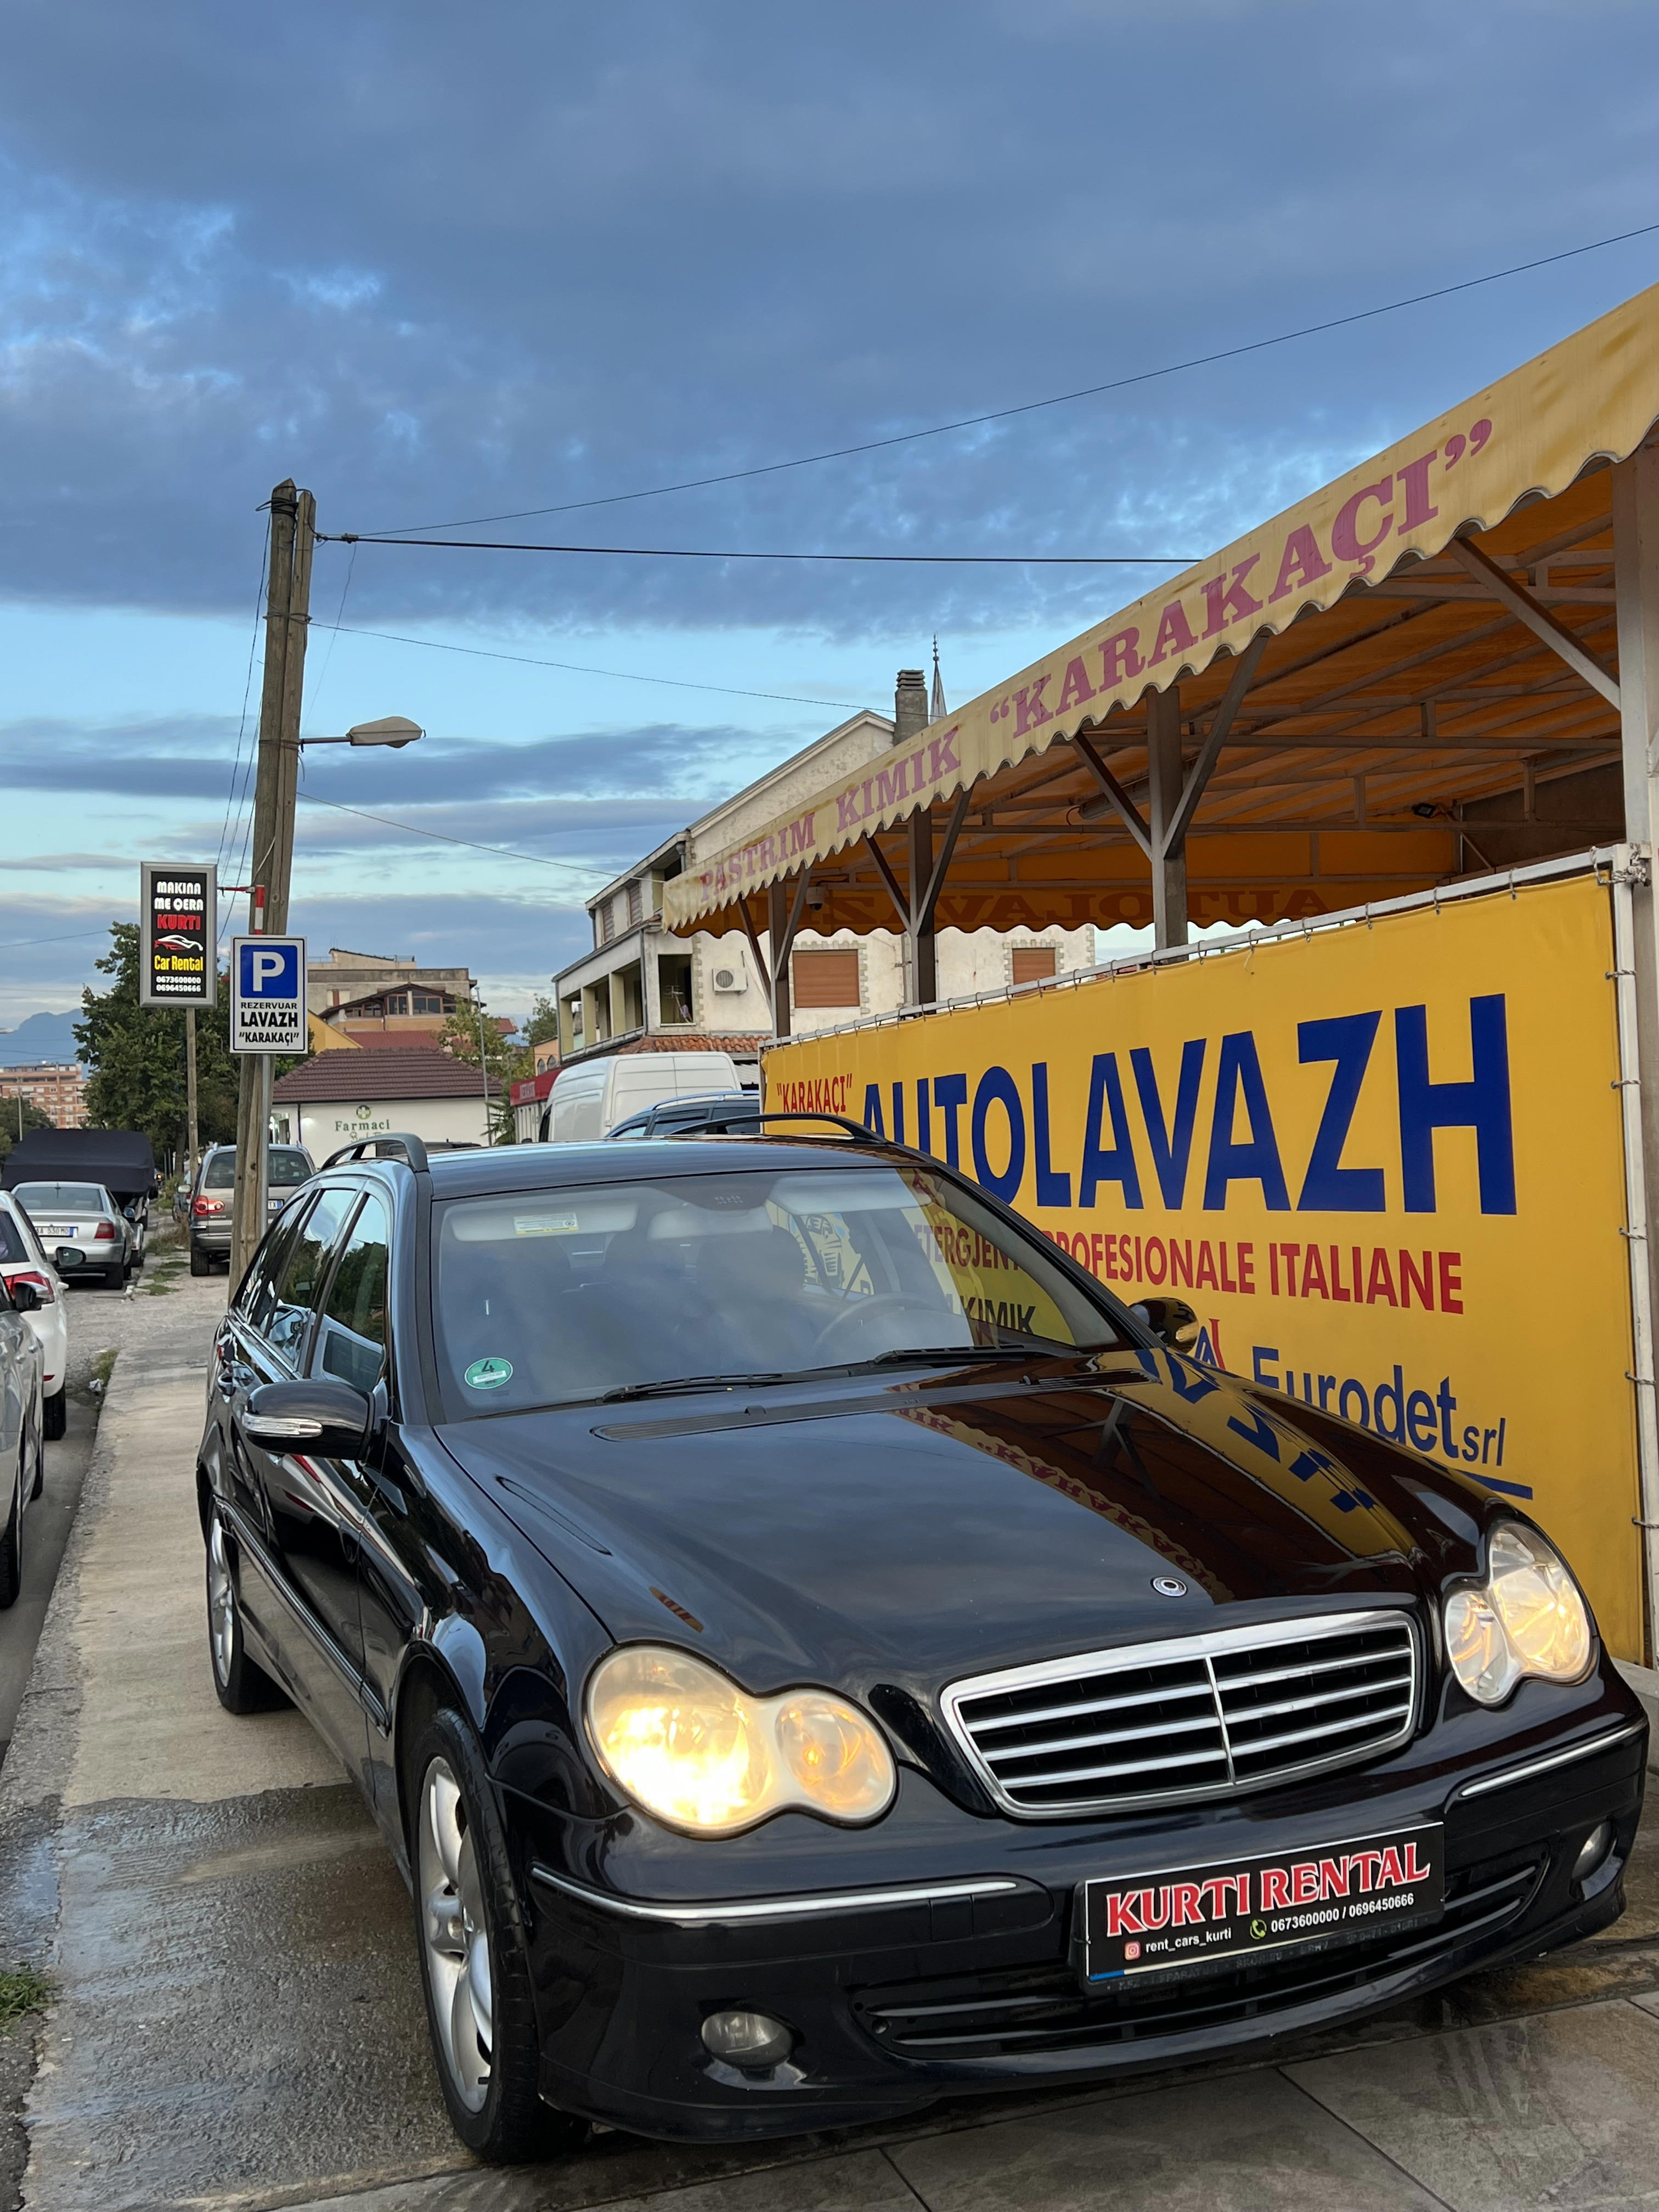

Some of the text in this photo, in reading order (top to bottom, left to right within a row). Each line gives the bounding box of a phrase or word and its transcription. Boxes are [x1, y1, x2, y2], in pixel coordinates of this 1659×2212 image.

[699, 418, 1492, 903] PASTRIM KIMIK “KARAKAÇI”
[157, 881, 201, 895] MAKINA
[154, 898, 204, 911] ME QERA
[157, 914, 201, 930] KURTI
[154, 955, 204, 972] Car Rental
[252, 951, 285, 992] P
[156, 976, 201, 984] 0673600000
[156, 984, 201, 992] 0696450666
[241, 1012, 298, 1028] LAVAZH
[239, 1031, 300, 1046] “KARAKAÇI”
[776, 1073, 853, 1116] "KARAKAÇI"
[862, 992, 1517, 1216] AUTOLAVAZH
[335, 1119, 390, 1131] Farmaci
[1269, 1243, 1464, 1315] ITALIANE
[482, 1360, 495, 1373] 4
[1252, 1345, 1506, 1466] Eurodet srl
[1106, 1842, 1431, 1937] KURTI RENTAL
[1146, 1927, 1232, 1954] rent_cars_kurti
[1271, 1908, 1340, 1934] 0673600000
[1341, 1906, 1347, 1920] /
[1348, 1893, 1414, 1917] 0696450666
